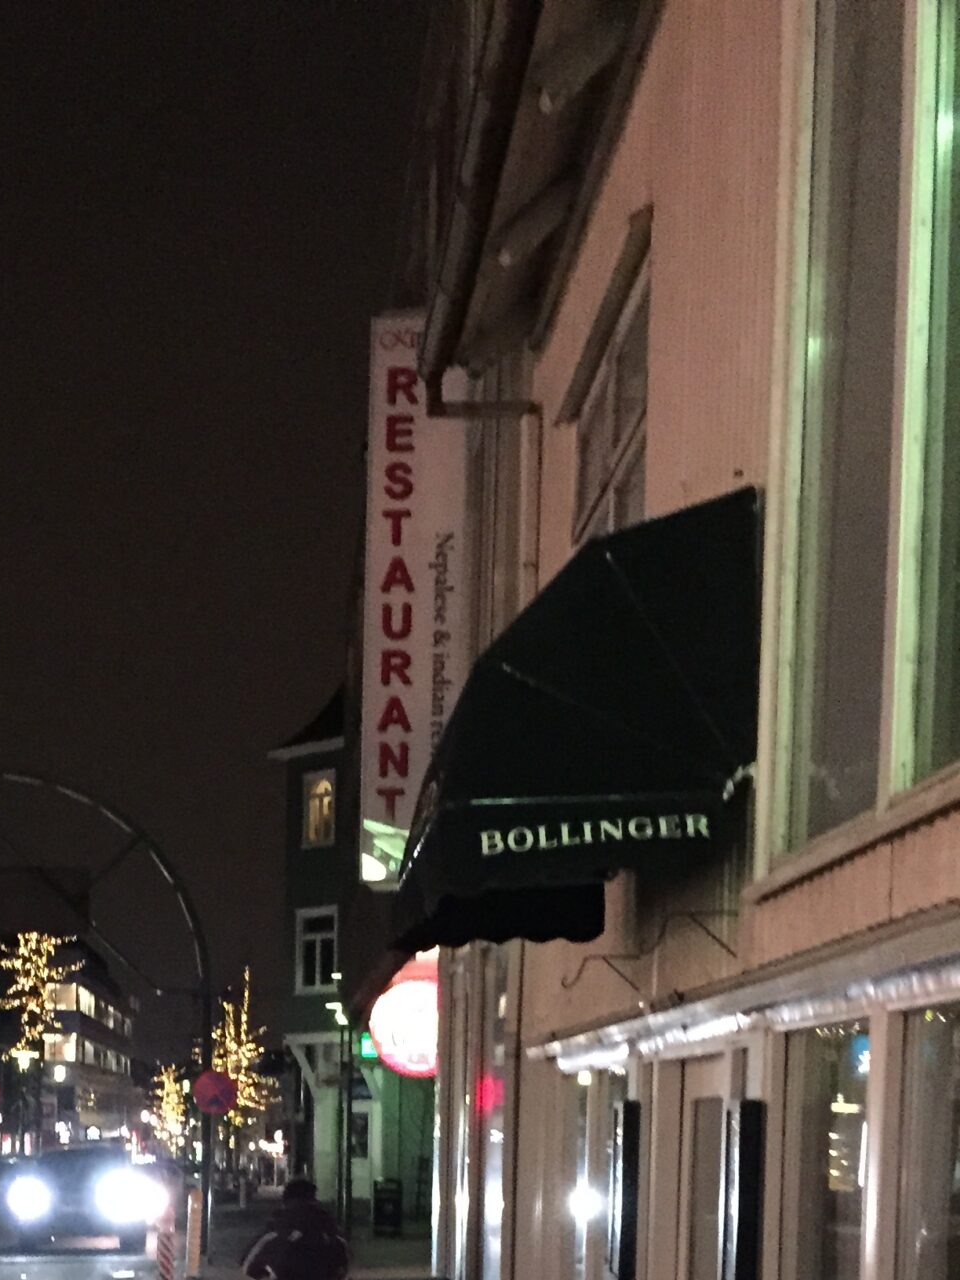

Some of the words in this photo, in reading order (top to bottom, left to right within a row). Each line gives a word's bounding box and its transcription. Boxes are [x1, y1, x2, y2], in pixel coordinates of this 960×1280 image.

[376, 366, 419, 821] RESTAURANT
[429, 531, 455, 625] Nepalese
[433, 629, 451, 648] &
[480, 813, 711, 857] BOLLINGER
